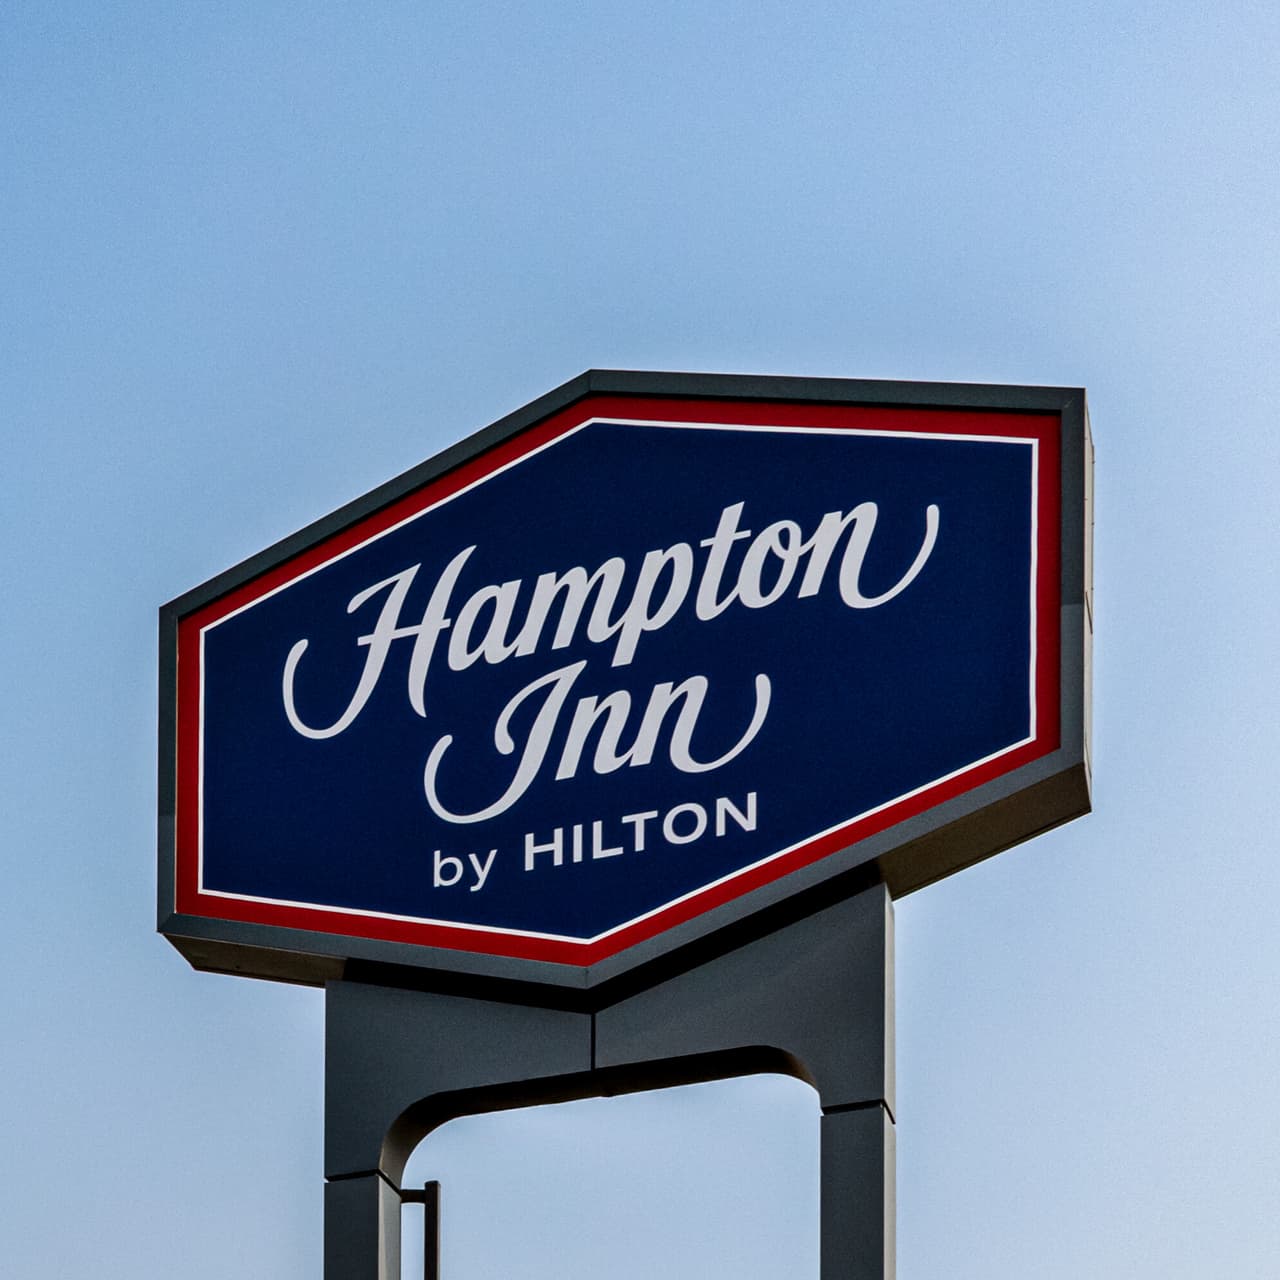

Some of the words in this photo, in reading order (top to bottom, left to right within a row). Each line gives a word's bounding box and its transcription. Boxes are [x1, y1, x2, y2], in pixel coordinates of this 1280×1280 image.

[282, 500, 940, 740] Hampton
[423, 659, 772, 824] Inn
[433, 849, 498, 892] by
[524, 791, 757, 872] HILTON
